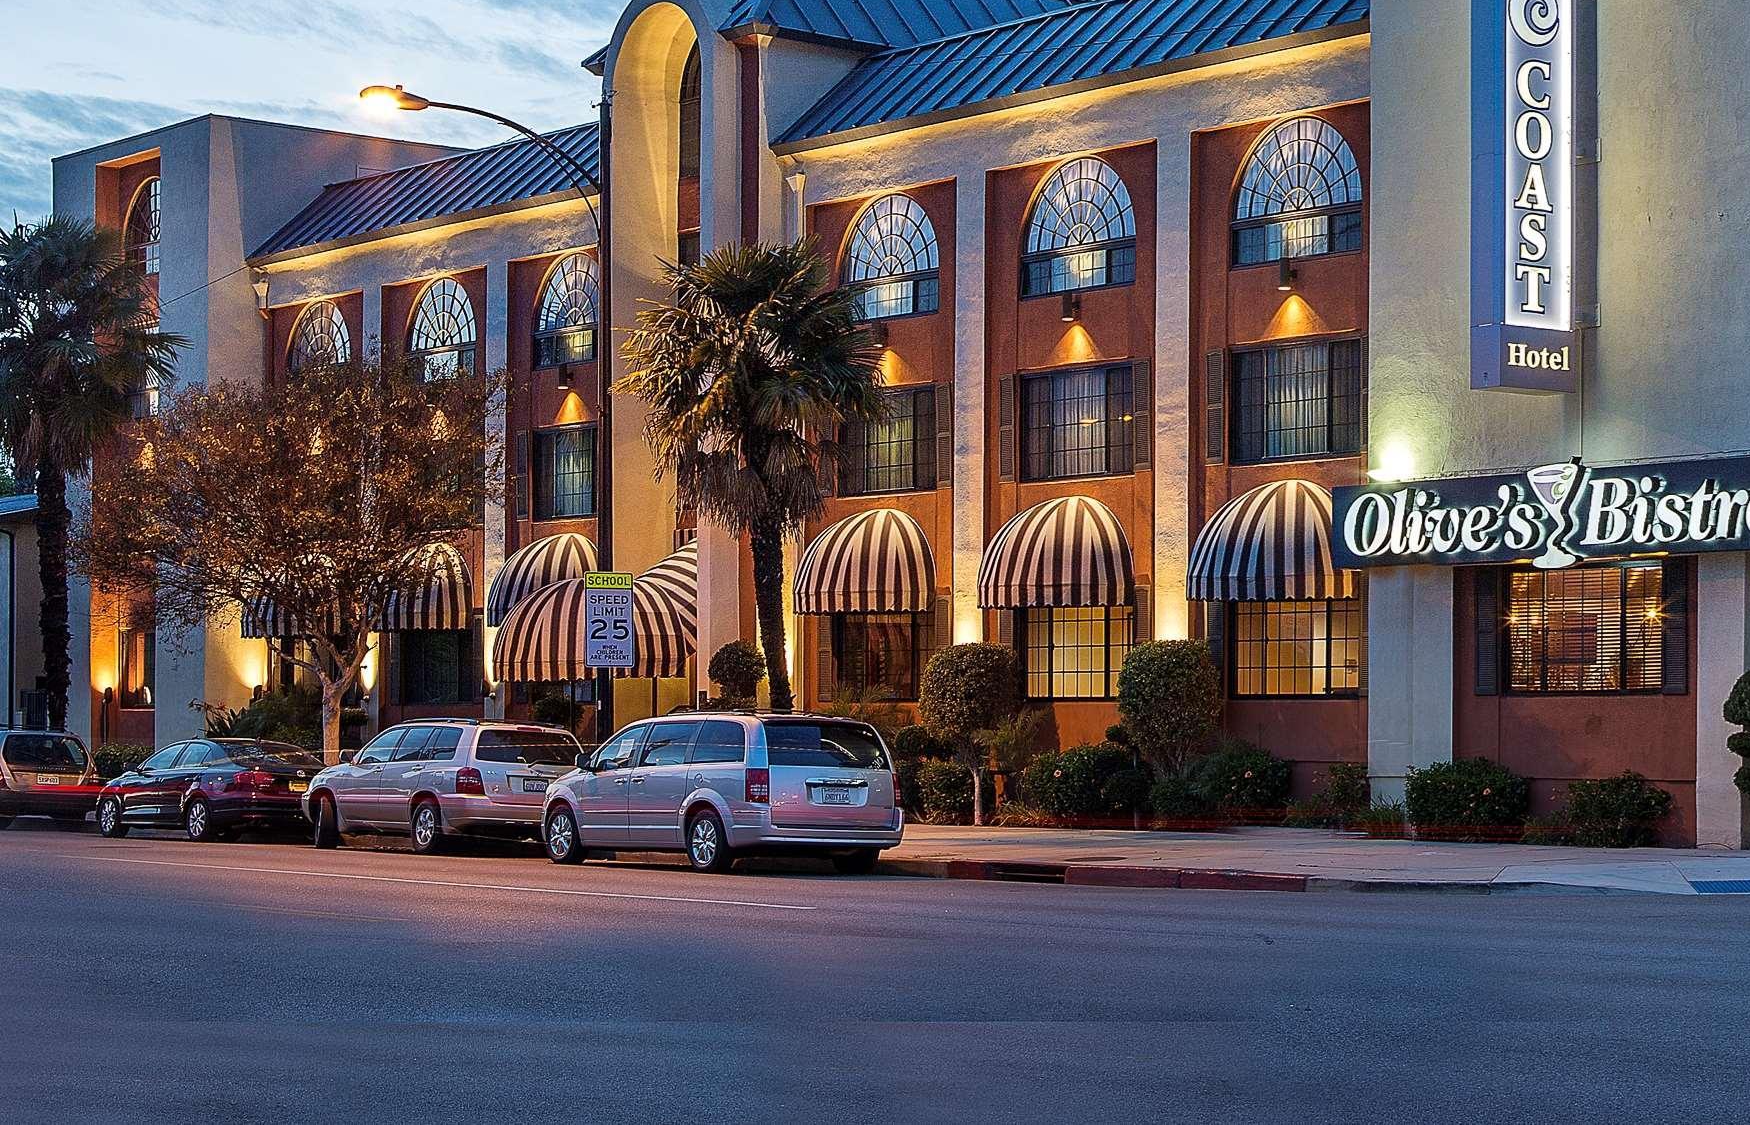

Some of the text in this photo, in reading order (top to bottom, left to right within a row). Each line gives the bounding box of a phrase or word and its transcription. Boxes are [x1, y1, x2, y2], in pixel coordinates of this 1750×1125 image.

[1514, 60, 1553, 314] COAST
[1507, 342, 1570, 372] Hotel
[1343, 483, 1545, 558] Olive's
[588, 576, 630, 586] SCHOOL
[590, 595, 629, 604] SPEED
[593, 607, 625, 616] LIMIT
[590, 619, 630, 640] 25
